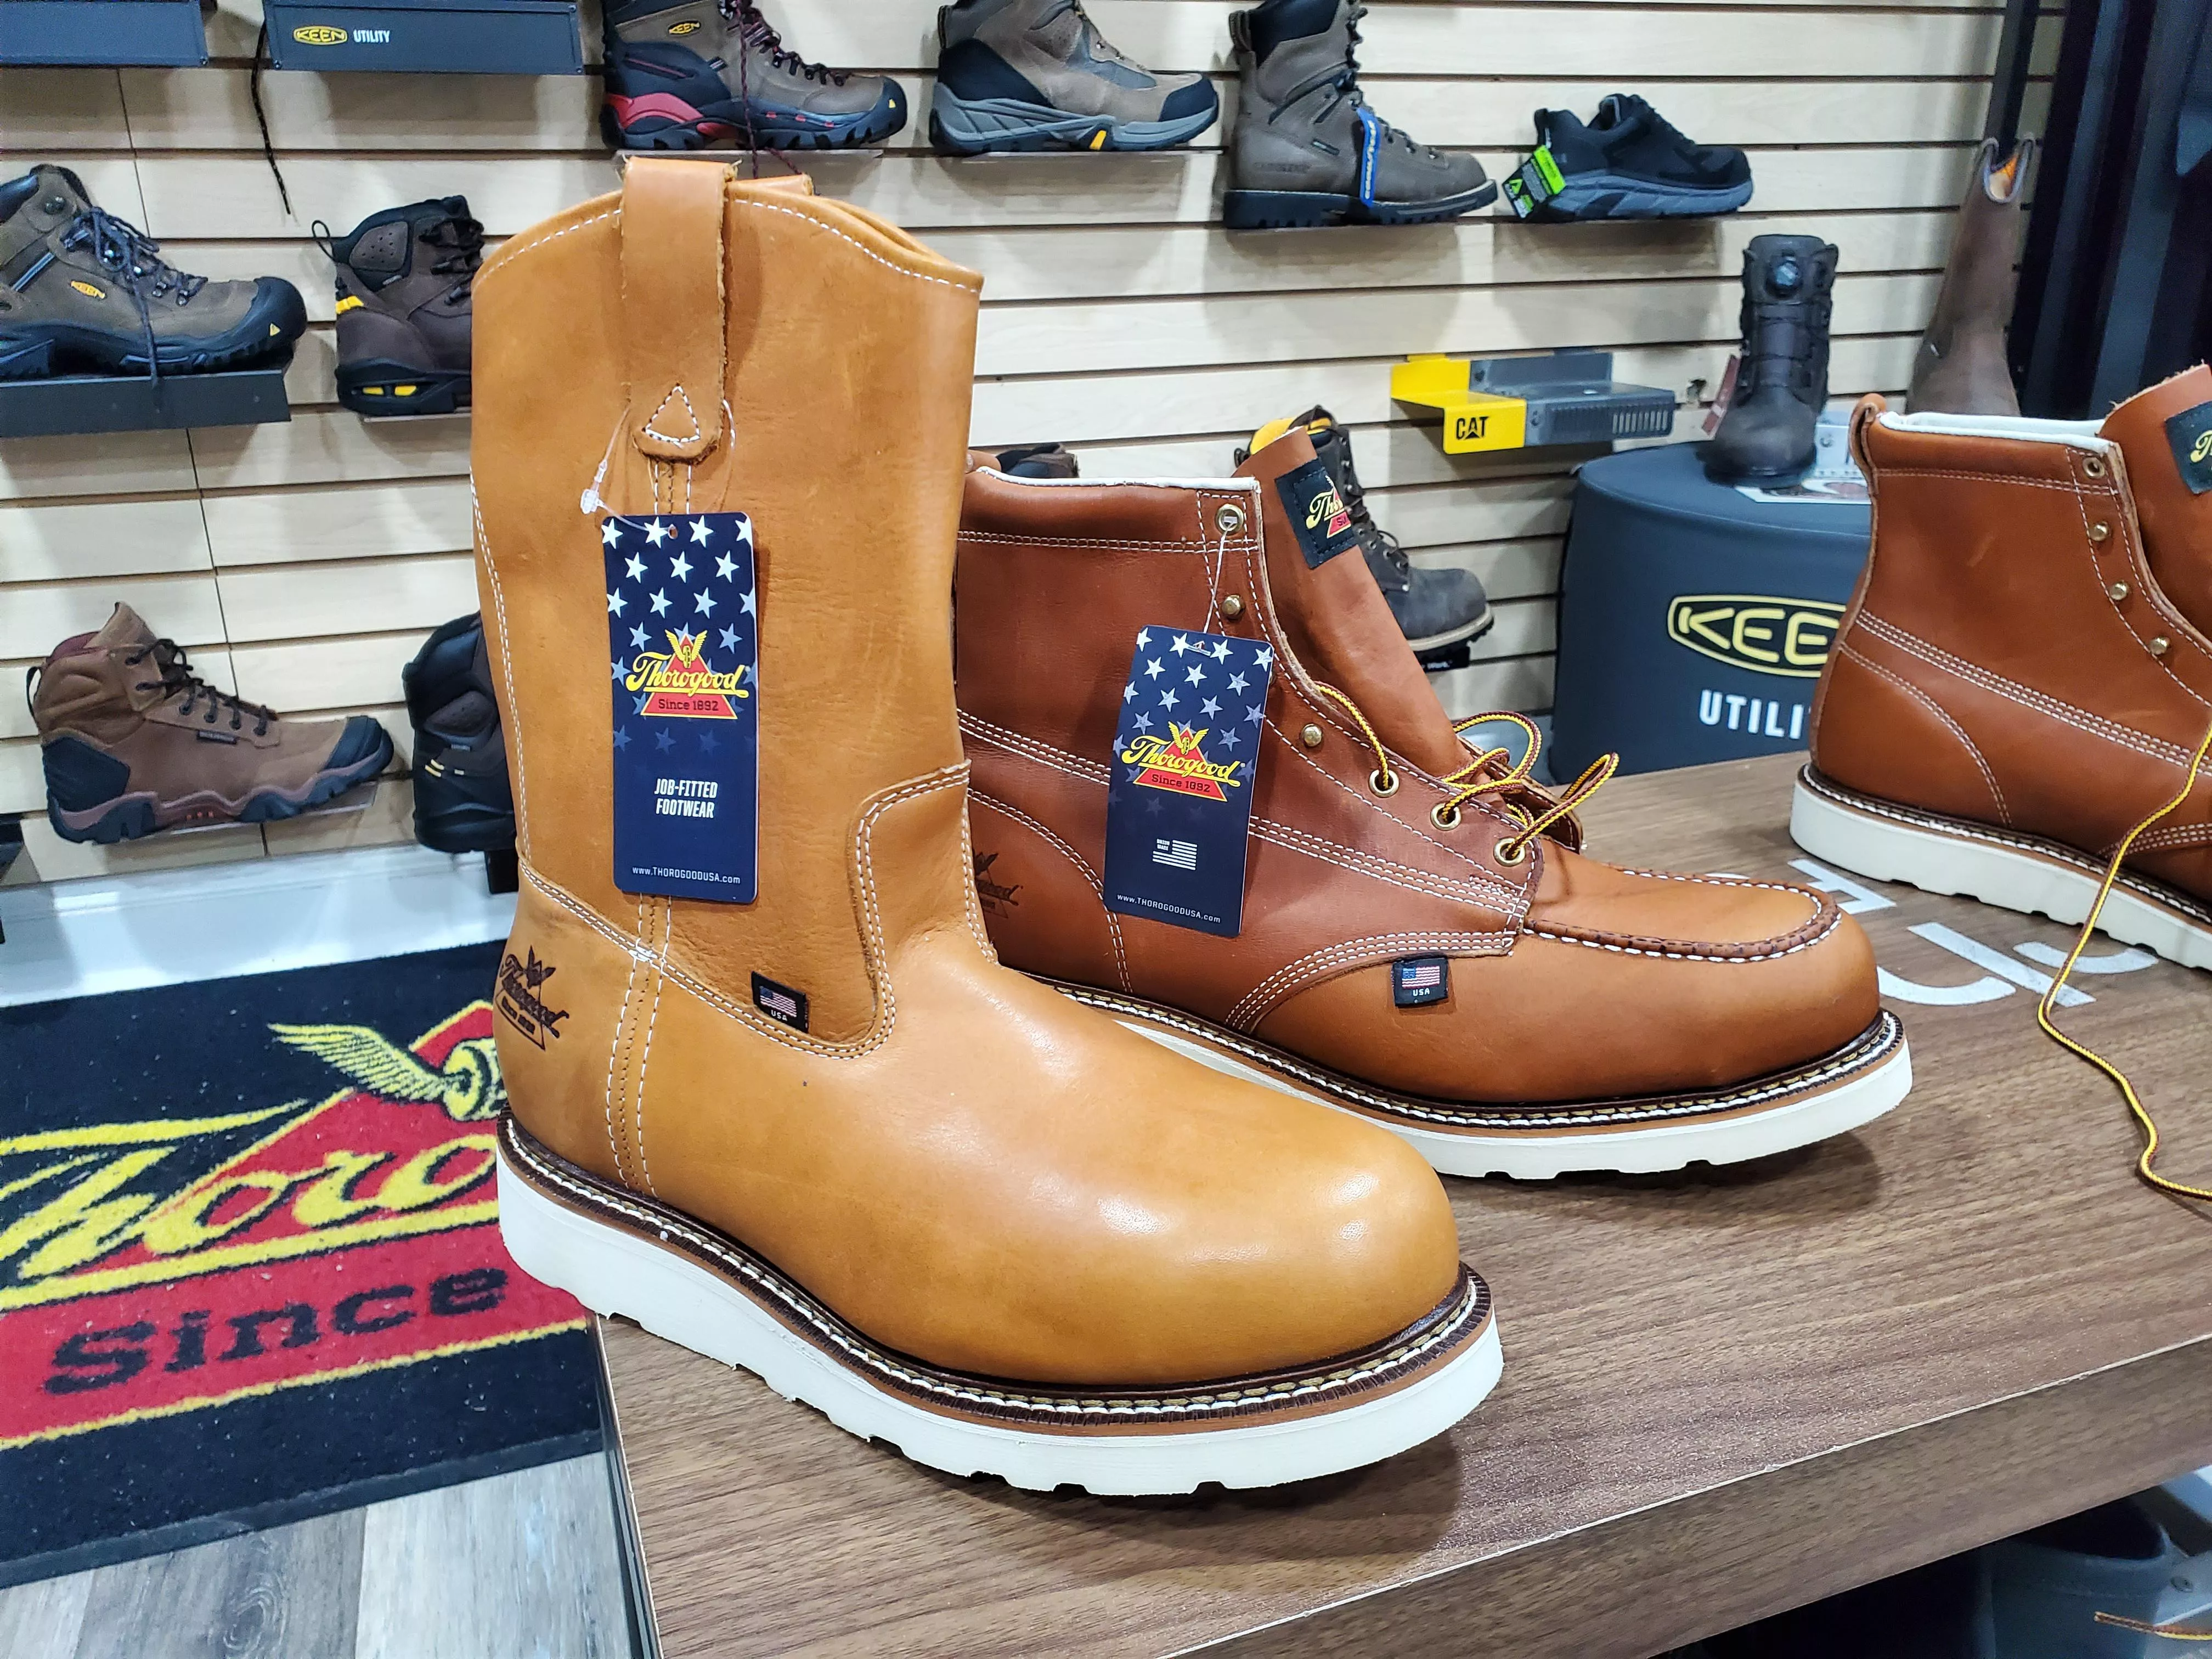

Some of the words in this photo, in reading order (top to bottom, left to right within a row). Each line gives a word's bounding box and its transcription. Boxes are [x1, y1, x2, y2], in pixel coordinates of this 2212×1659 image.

[296, 29, 345, 42] KEEN
[353, 29, 391, 43] UTILITY
[668, 22, 701, 34] KEEN
[1456, 416, 1489, 440] CAT
[1678, 606, 1840, 665] KEE
[625, 651, 749, 699] Thorogood
[658, 698, 690, 711] Since
[692, 700, 719, 712] 1892
[1699, 688, 1811, 740] UTILI
[1121, 735, 1242, 788] Thorogood
[654, 778, 719, 799] JOB-FITTED
[1152, 774, 1182, 788] Since
[1185, 780, 1211, 793] 1892
[656, 798, 715, 819] FOOTWEAR
[632, 866, 741, 884] www.THOROGOODUSA.com
[1116, 894, 1221, 924] www.THOROGOODUSA.com
[1413, 988, 1431, 996] USA
[771, 1009, 788, 1022] USA
[43, 1267, 508, 1395] Since
